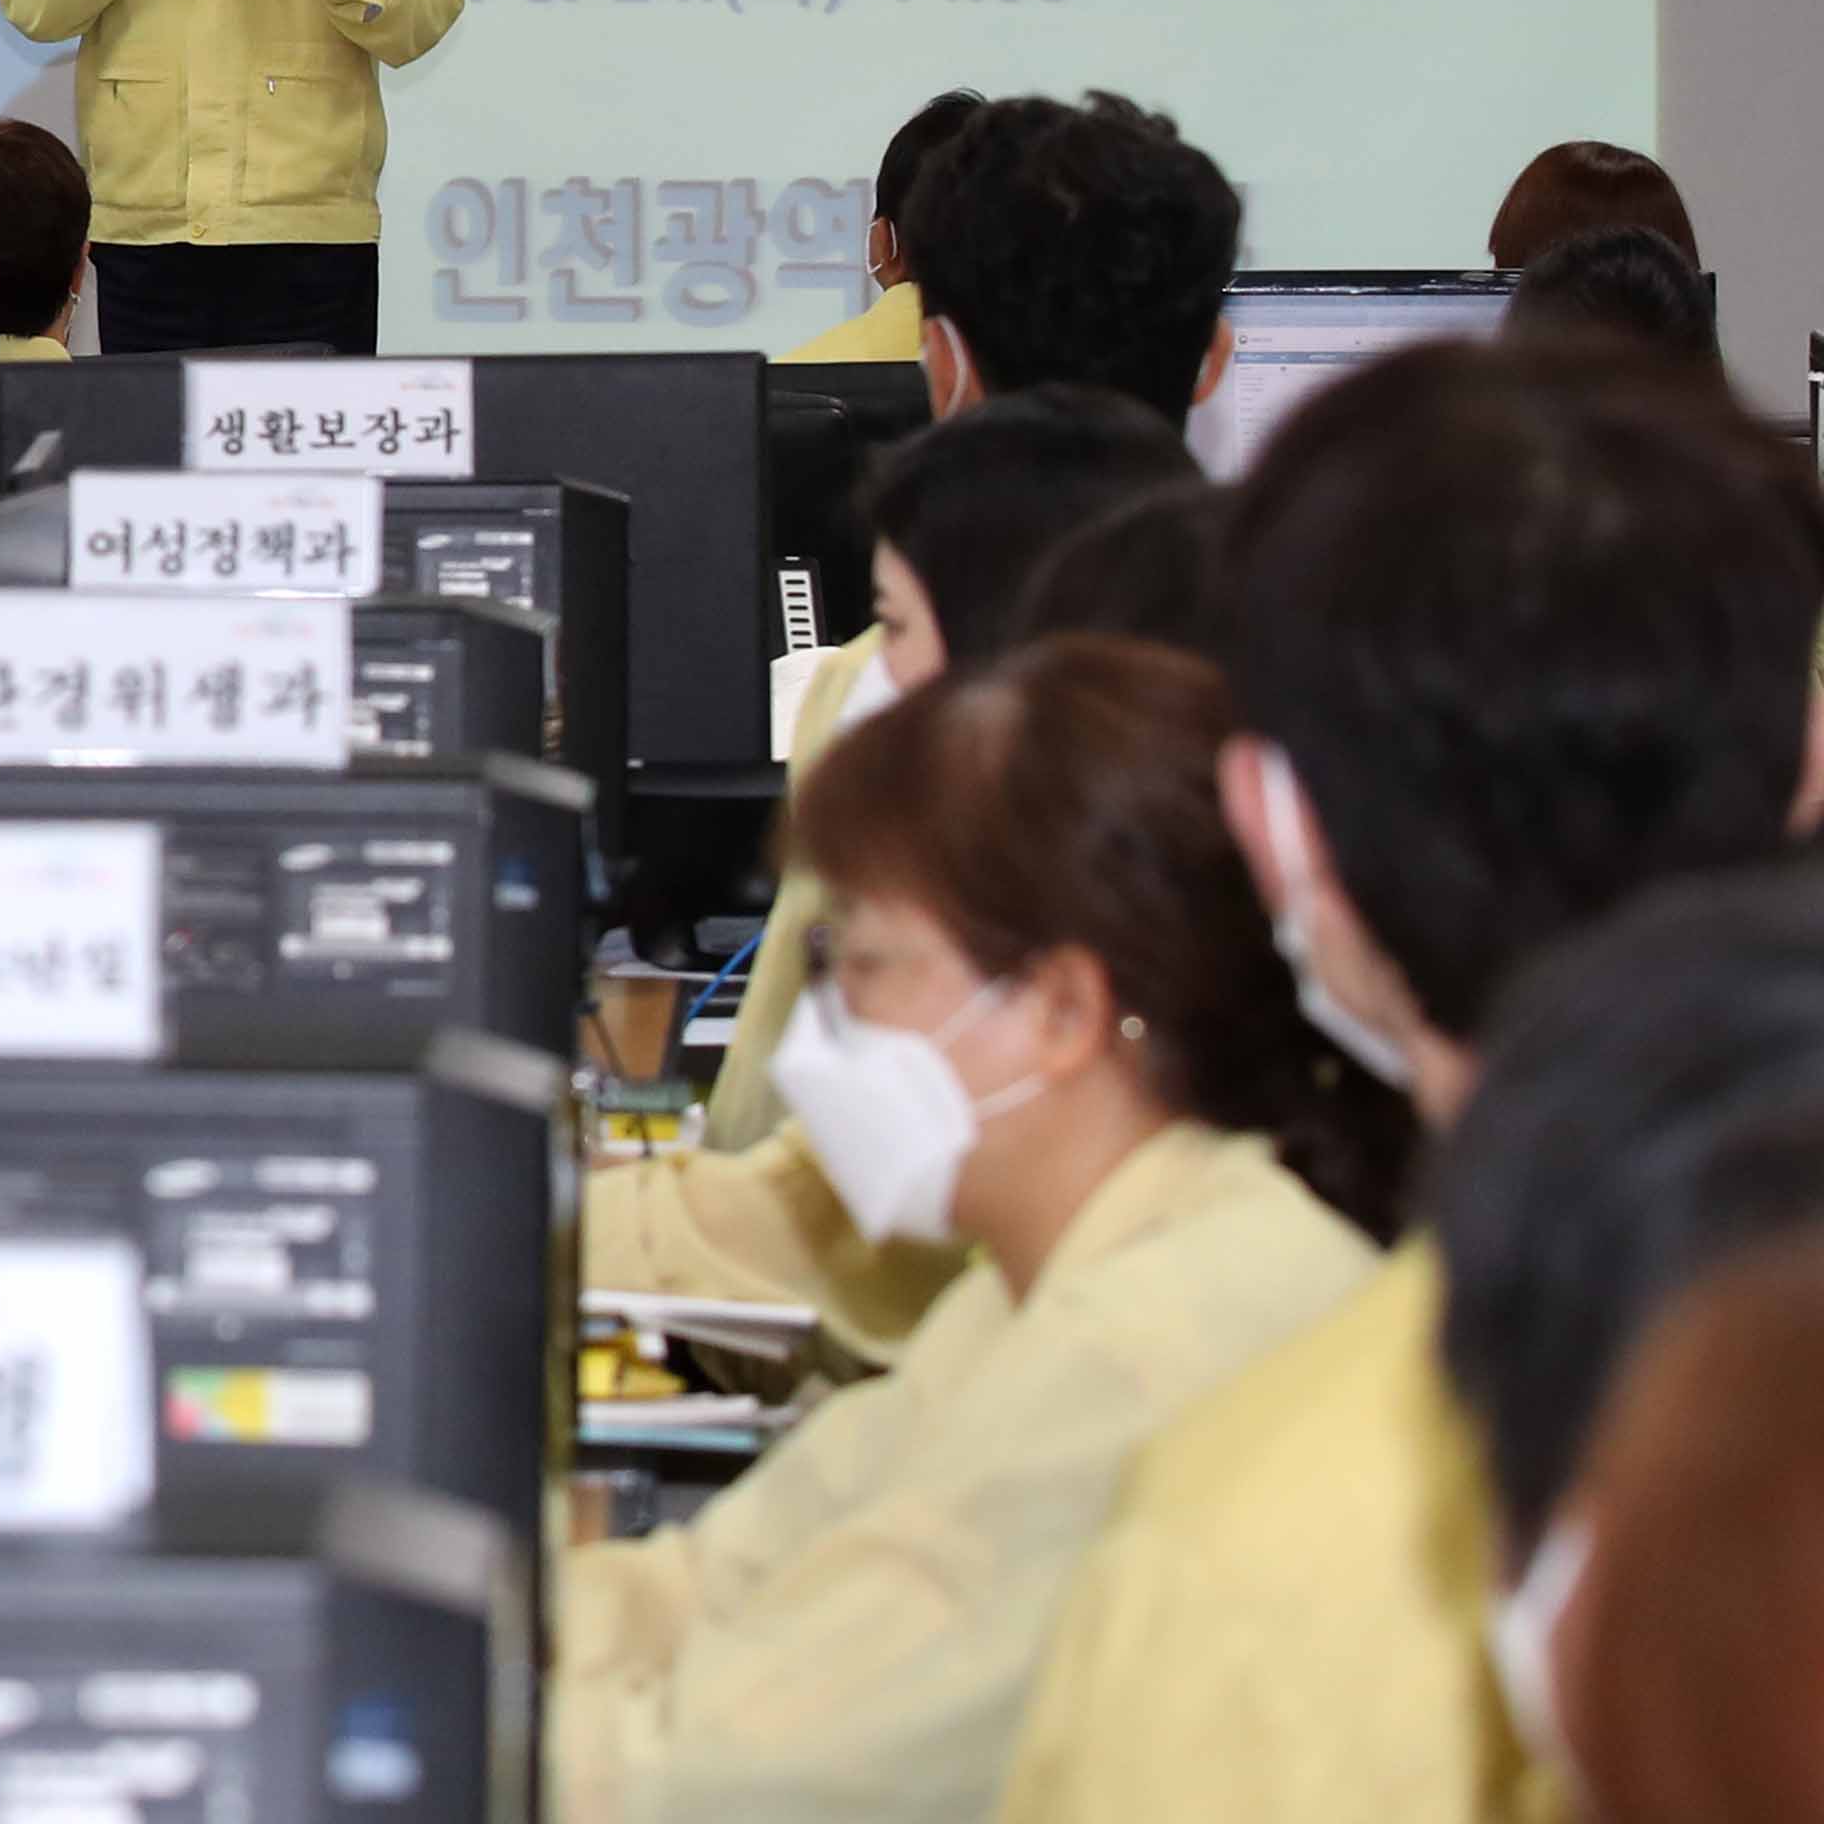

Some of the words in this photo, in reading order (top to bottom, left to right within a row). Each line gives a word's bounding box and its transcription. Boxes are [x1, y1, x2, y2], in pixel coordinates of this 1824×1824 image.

[425, 175, 874, 327] 인천광역
[210, 408, 462, 459] 생활보장과
[86, 519, 359, 577] 여성정책과
